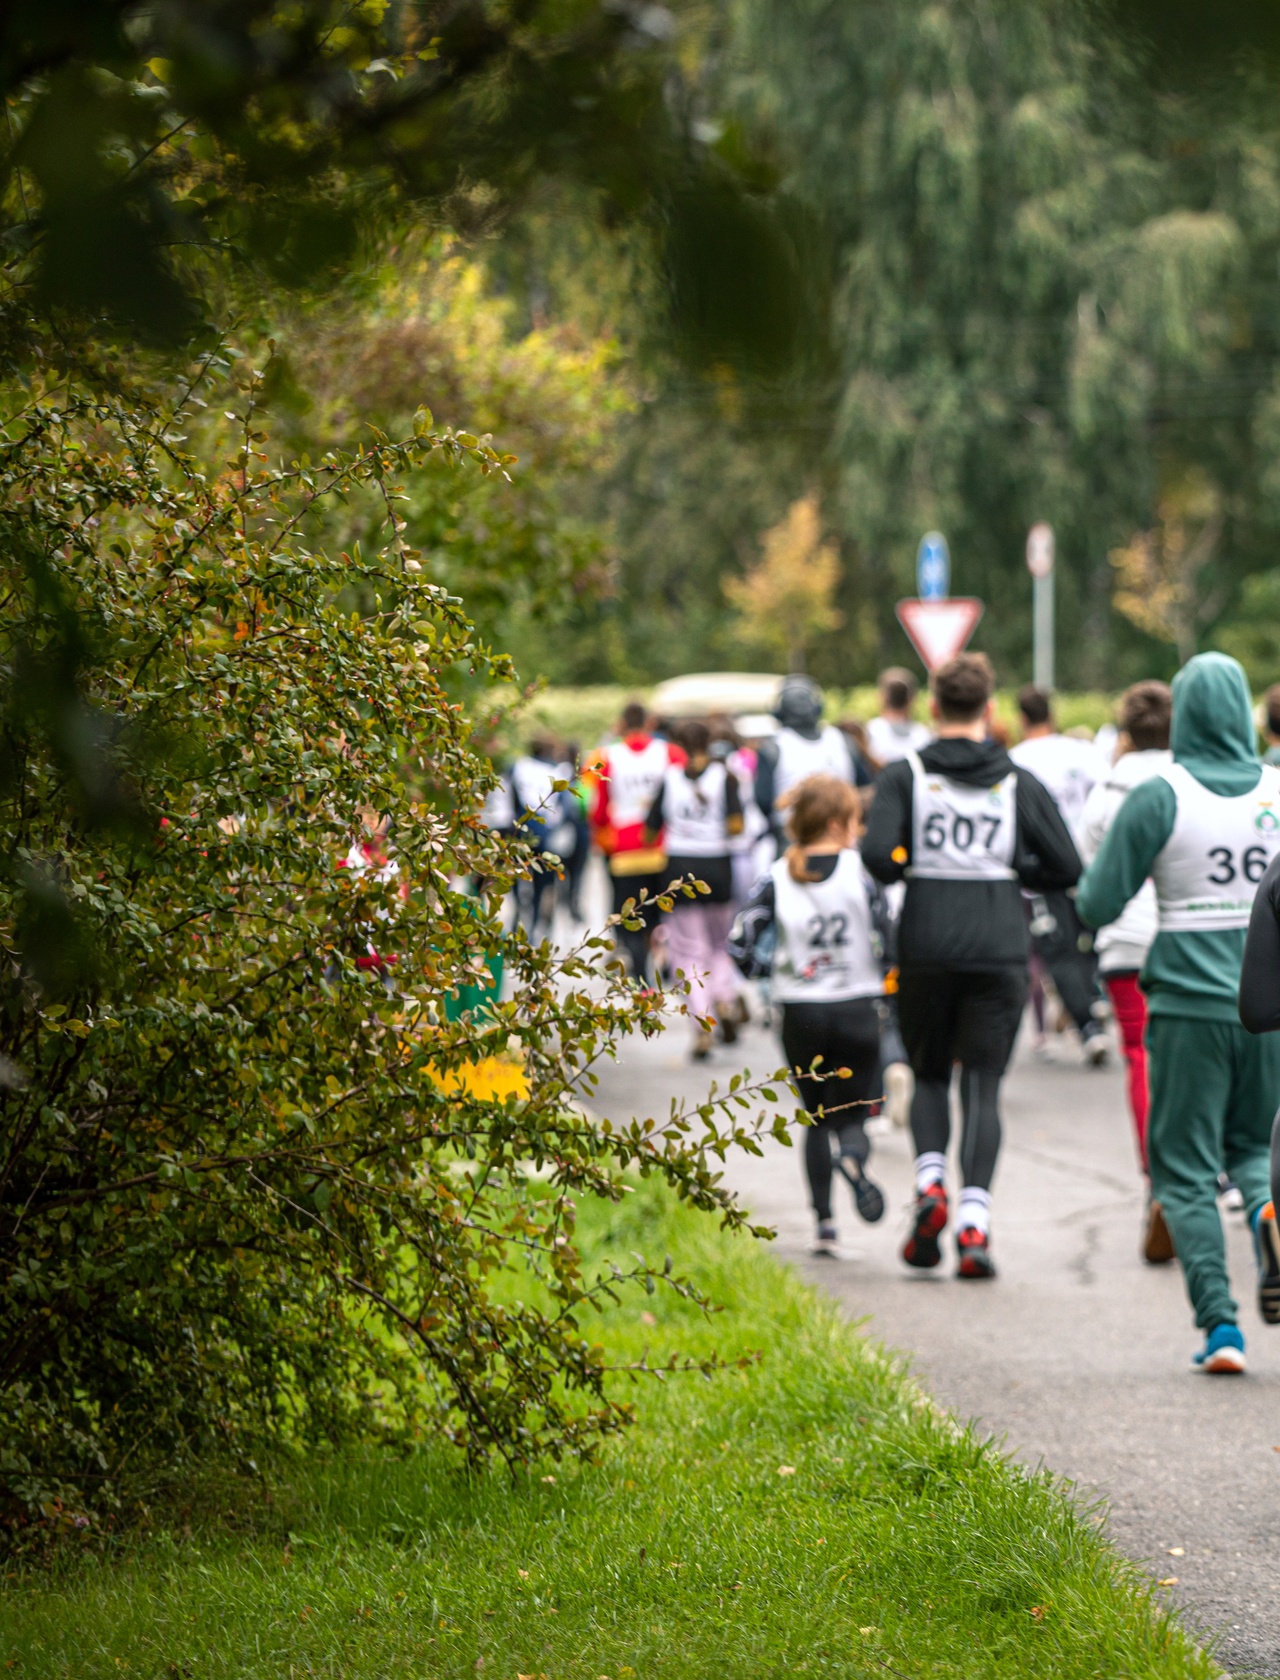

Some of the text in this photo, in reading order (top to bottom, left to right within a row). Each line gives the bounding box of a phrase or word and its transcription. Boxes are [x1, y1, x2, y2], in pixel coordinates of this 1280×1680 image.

[923, 813, 1002, 851] 607
[1208, 846, 1268, 886] 36
[808, 912, 849, 949] 22
